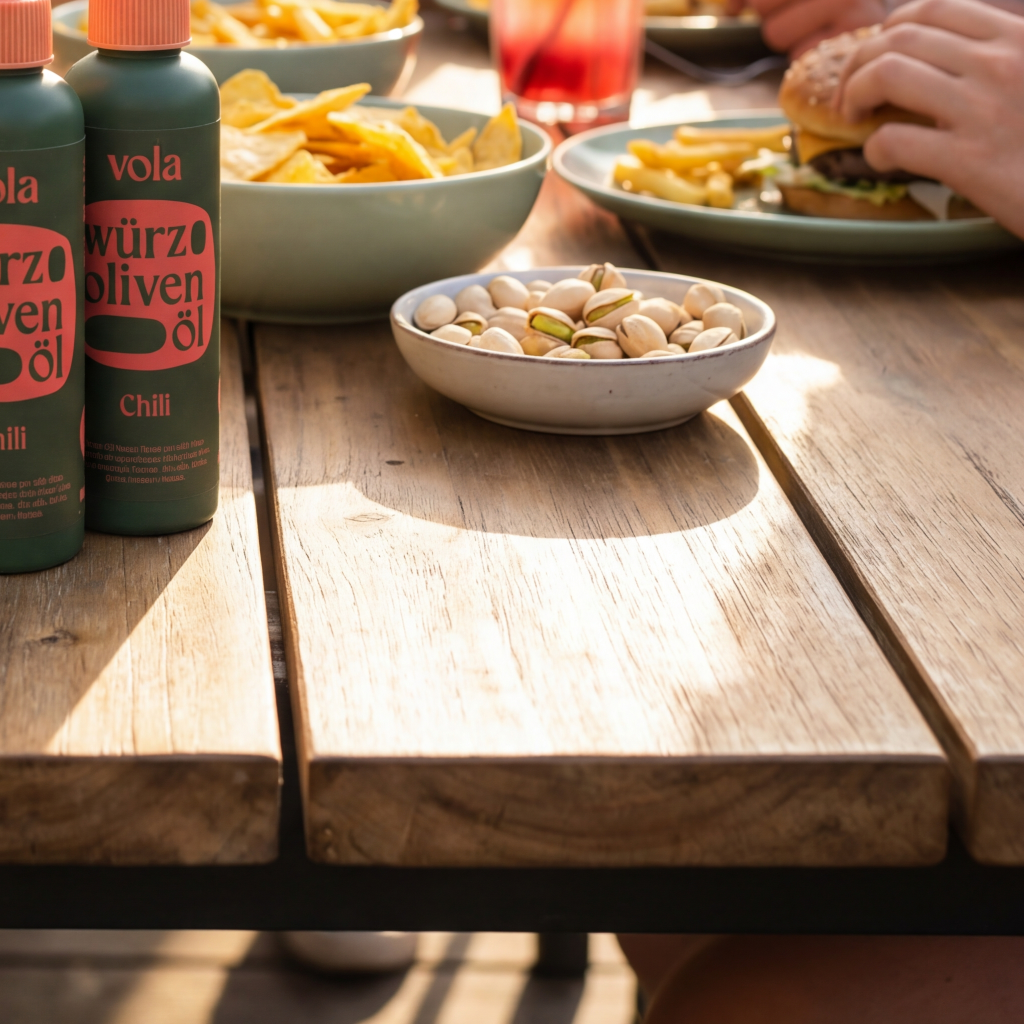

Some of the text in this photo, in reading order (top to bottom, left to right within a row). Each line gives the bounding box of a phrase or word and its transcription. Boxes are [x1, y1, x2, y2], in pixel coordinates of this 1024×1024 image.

[107, 145, 182, 182] vola
[85, 217, 187, 259] würz
[85, 262, 204, 307] oliven
[172, 304, 204, 352] öl
[28, 333, 64, 383] öl
[119, 393, 171, 417] Chili
